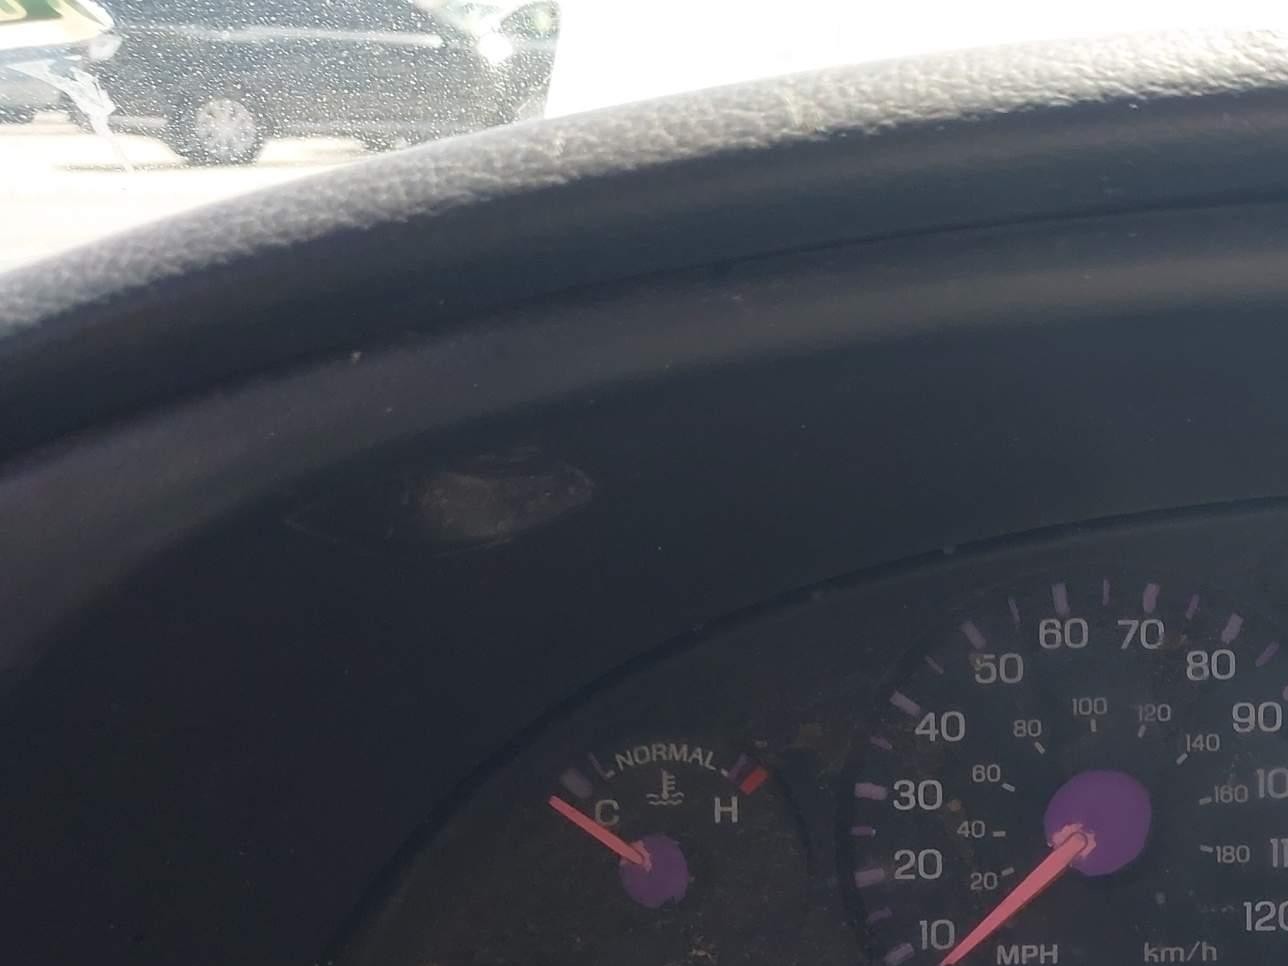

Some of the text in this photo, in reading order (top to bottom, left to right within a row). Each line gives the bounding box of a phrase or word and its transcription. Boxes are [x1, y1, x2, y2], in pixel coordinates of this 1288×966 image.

[1038, 617, 1090, 650] 60
[1116, 617, 1166, 650] 70
[973, 652, 1024, 686] 50
[1185, 648, 1236, 681] 80
[1071, 696, 1108, 717] 100
[1137, 703, 1172, 724] 120
[1231, 700, 1283, 734] 90
[914, 711, 966, 743] 40
[1013, 719, 1042, 738] 80
[1185, 732, 1221, 753] 140
[614, 742, 719, 773] NORMAL
[971, 763, 1001, 784] 60
[892, 779, 944, 812] 30
[1213, 784, 1249, 804] 160
[594, 799, 620, 827] C
[713, 795, 740, 824] H
[956, 820, 986, 840] 40
[893, 848, 944, 881] 20
[1215, 844, 1251, 864] 180
[969, 871, 998, 892] 20
[918, 918, 957, 952] 10
[995, 944, 1059, 965] MPH
[1143, 941, 1218, 964] km/h
